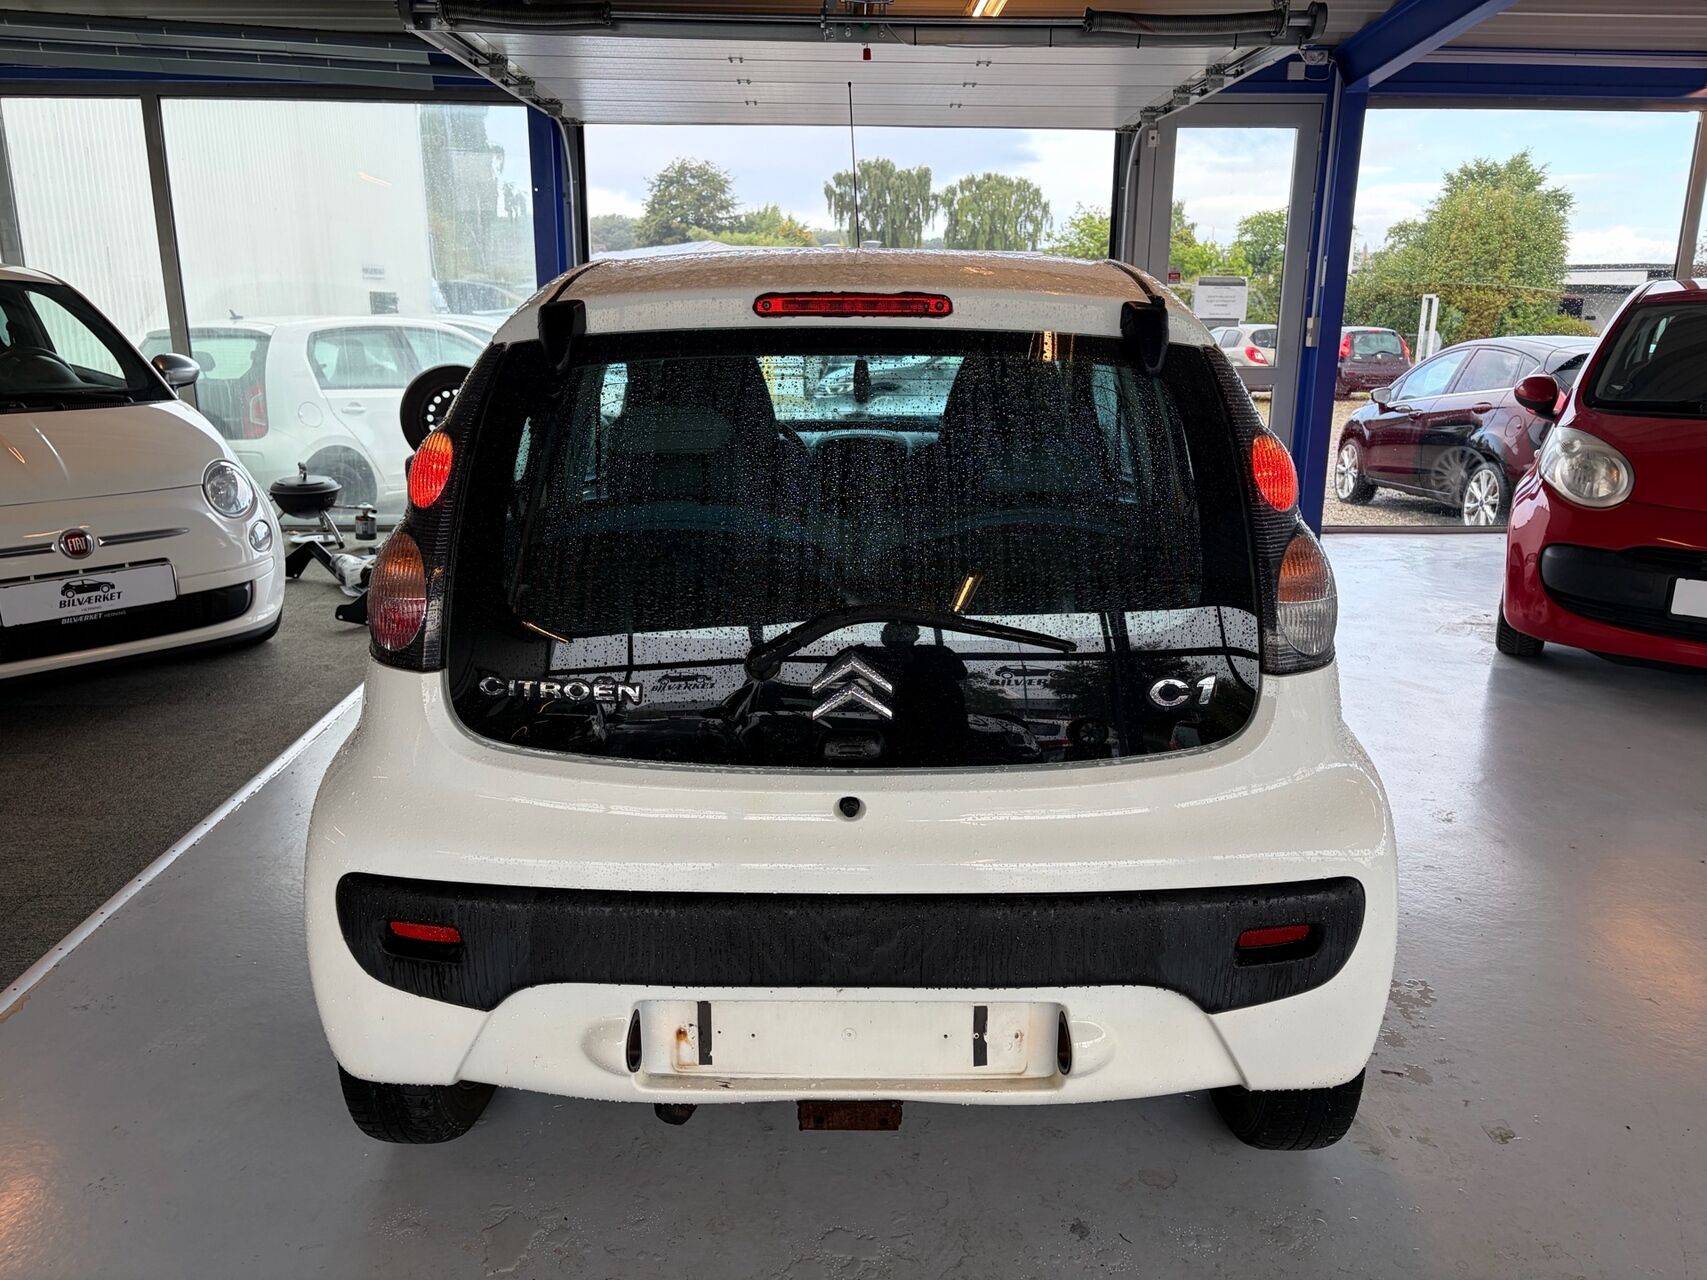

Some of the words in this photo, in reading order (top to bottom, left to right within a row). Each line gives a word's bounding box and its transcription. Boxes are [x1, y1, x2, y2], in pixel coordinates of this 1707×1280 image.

[67, 537, 87, 551] FIAT
[59, 591, 123, 609] BILVÆRKET
[61, 612, 104, 625] BILVÆRKET
[479, 676, 641, 702] CITROËN
[1149, 676, 1216, 706] C1
